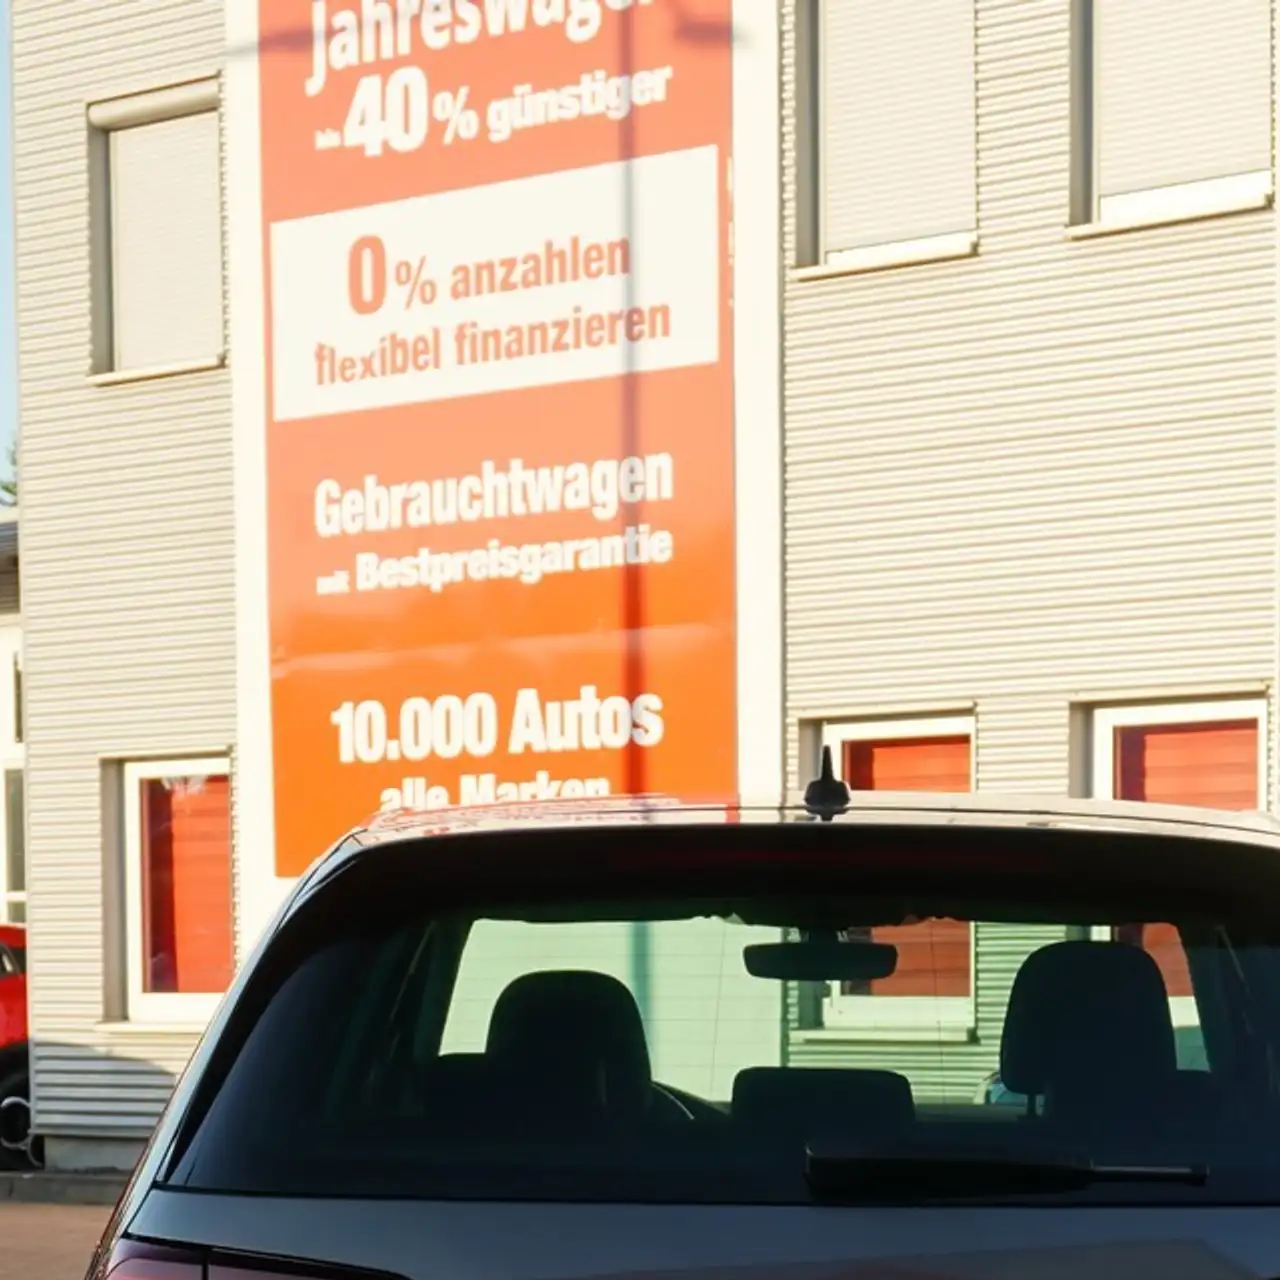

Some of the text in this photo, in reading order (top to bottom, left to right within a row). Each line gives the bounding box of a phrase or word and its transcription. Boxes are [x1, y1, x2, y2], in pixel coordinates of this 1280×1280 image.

[305, 0, 655, 96] Jahreswag
[342, 66, 429, 157] 40
[487, 66, 673, 142] günstiger
[347, 235, 387, 315] 0
[450, 235, 630, 300] anzahlen
[314, 303, 671, 386] flexibel finanzieren
[314, 451, 674, 538] Gebrauchtwagen
[355, 524, 673, 594] Bestpreisgarantie
[330, 685, 664, 764] 10.000 Autos
[380, 770, 610, 812] alle Marken
